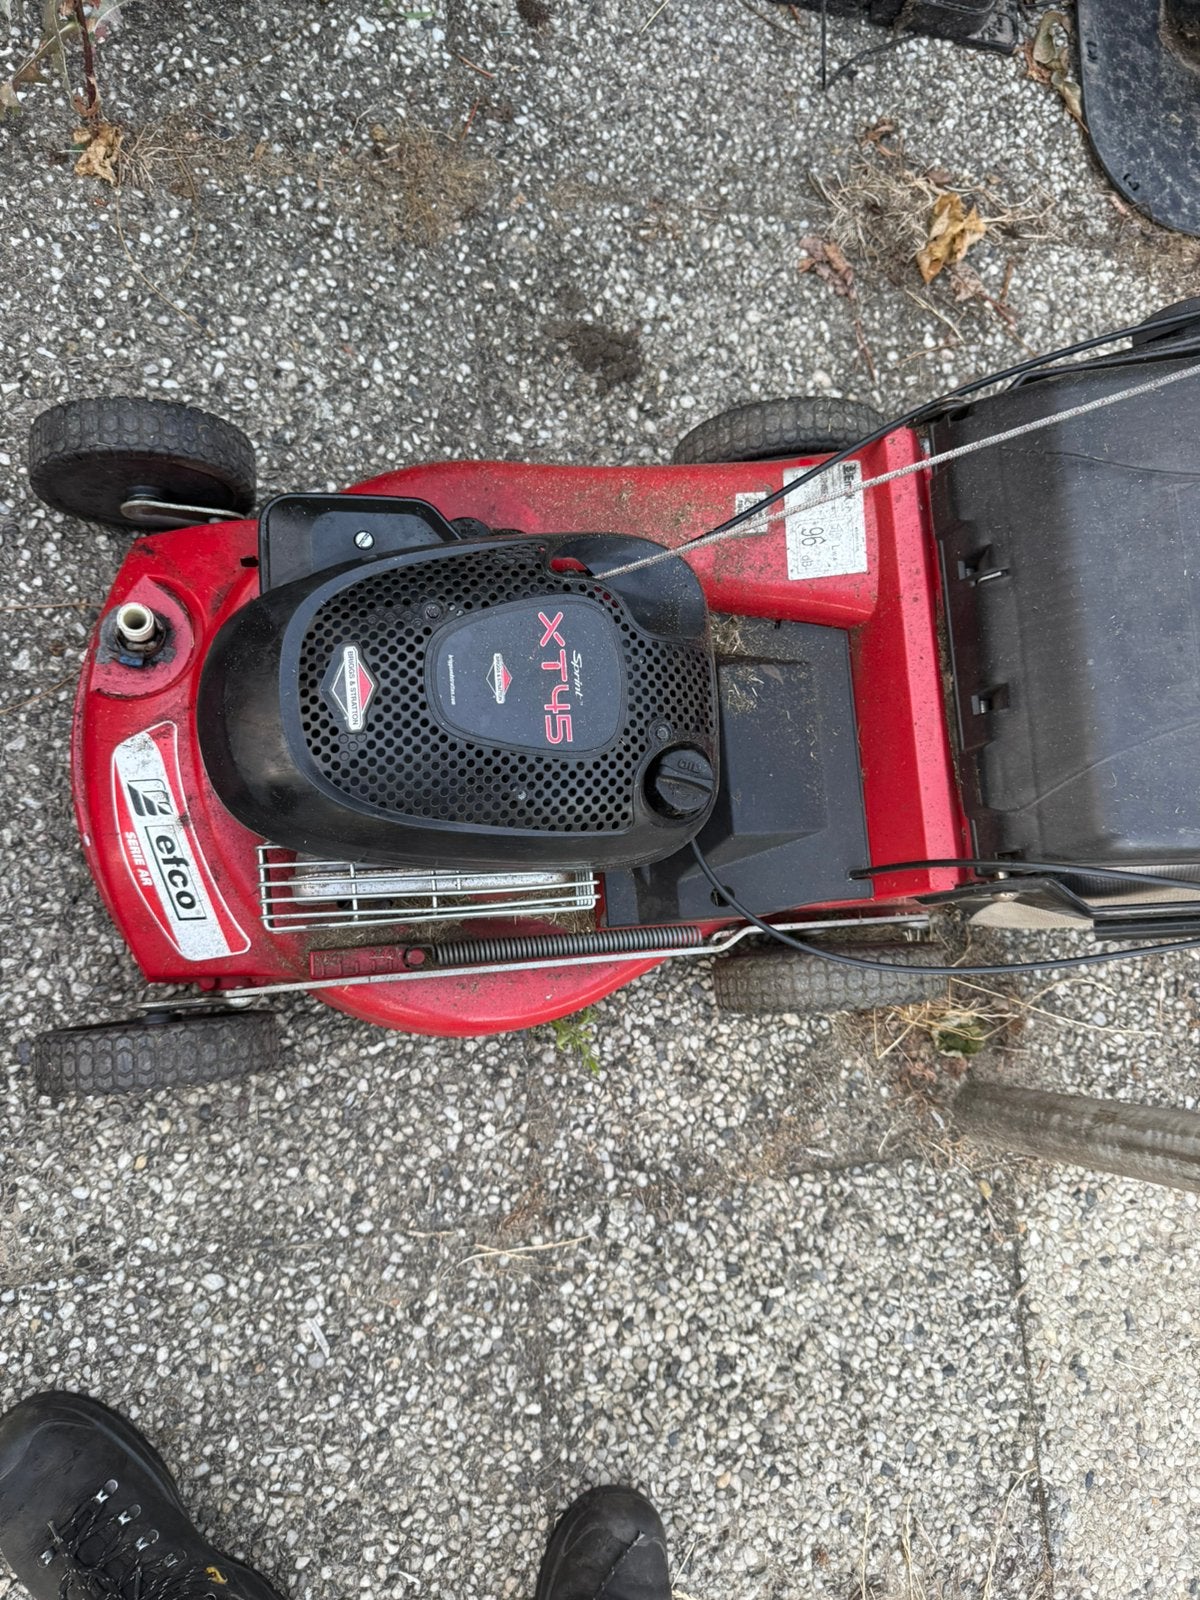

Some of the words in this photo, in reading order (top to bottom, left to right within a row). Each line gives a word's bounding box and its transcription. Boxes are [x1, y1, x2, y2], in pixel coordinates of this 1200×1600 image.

[801, 527, 826, 546] 96
[347, 650, 356, 679] BRIGGS
[537, 611, 573, 744] XT45
[570, 650, 583, 699] Sprint
[350, 687, 359, 725] STRATTON
[125, 831, 146, 866] SERIE
[137, 868, 153, 886] AR
[155, 835, 197, 910] efco
